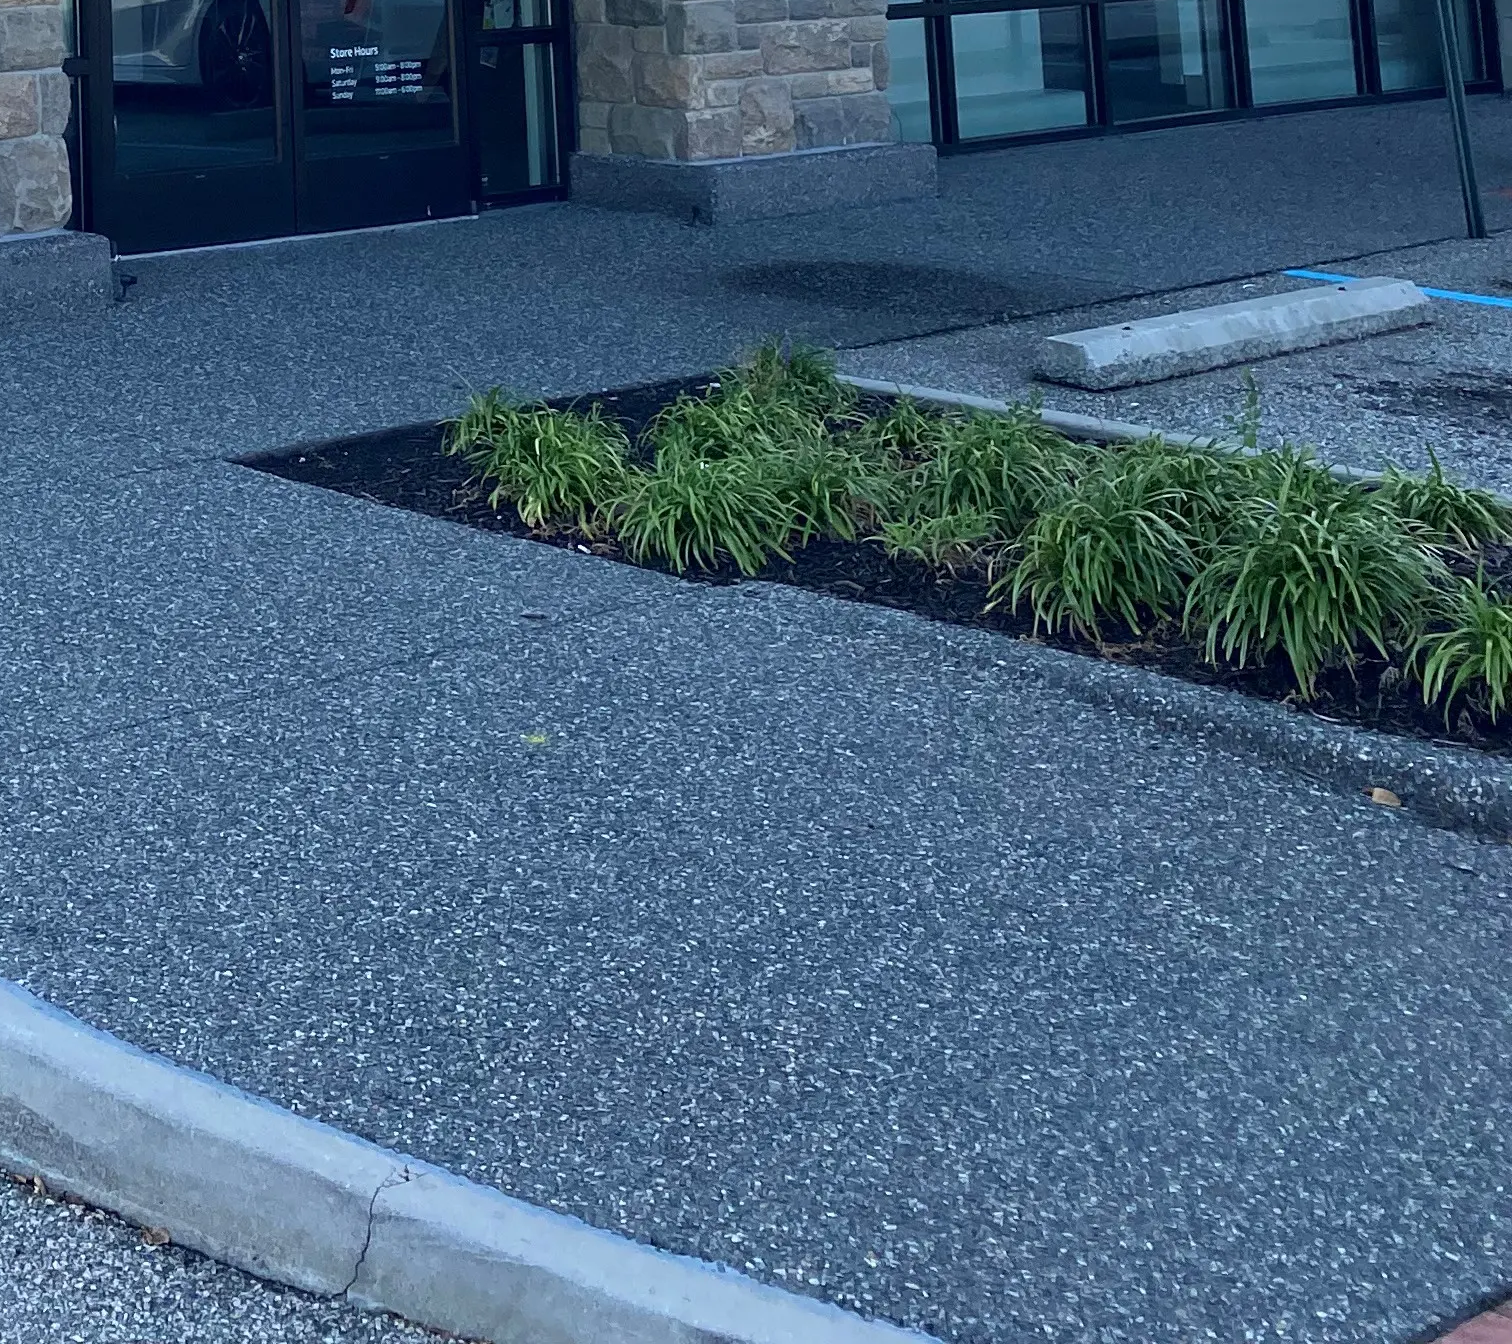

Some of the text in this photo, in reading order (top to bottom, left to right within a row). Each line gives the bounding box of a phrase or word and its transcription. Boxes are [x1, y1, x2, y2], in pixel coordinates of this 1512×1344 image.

[330, 46, 378, 59] Store Hours
[331, 78, 357, 87] Saturday
[331, 92, 354, 100] Sunday
